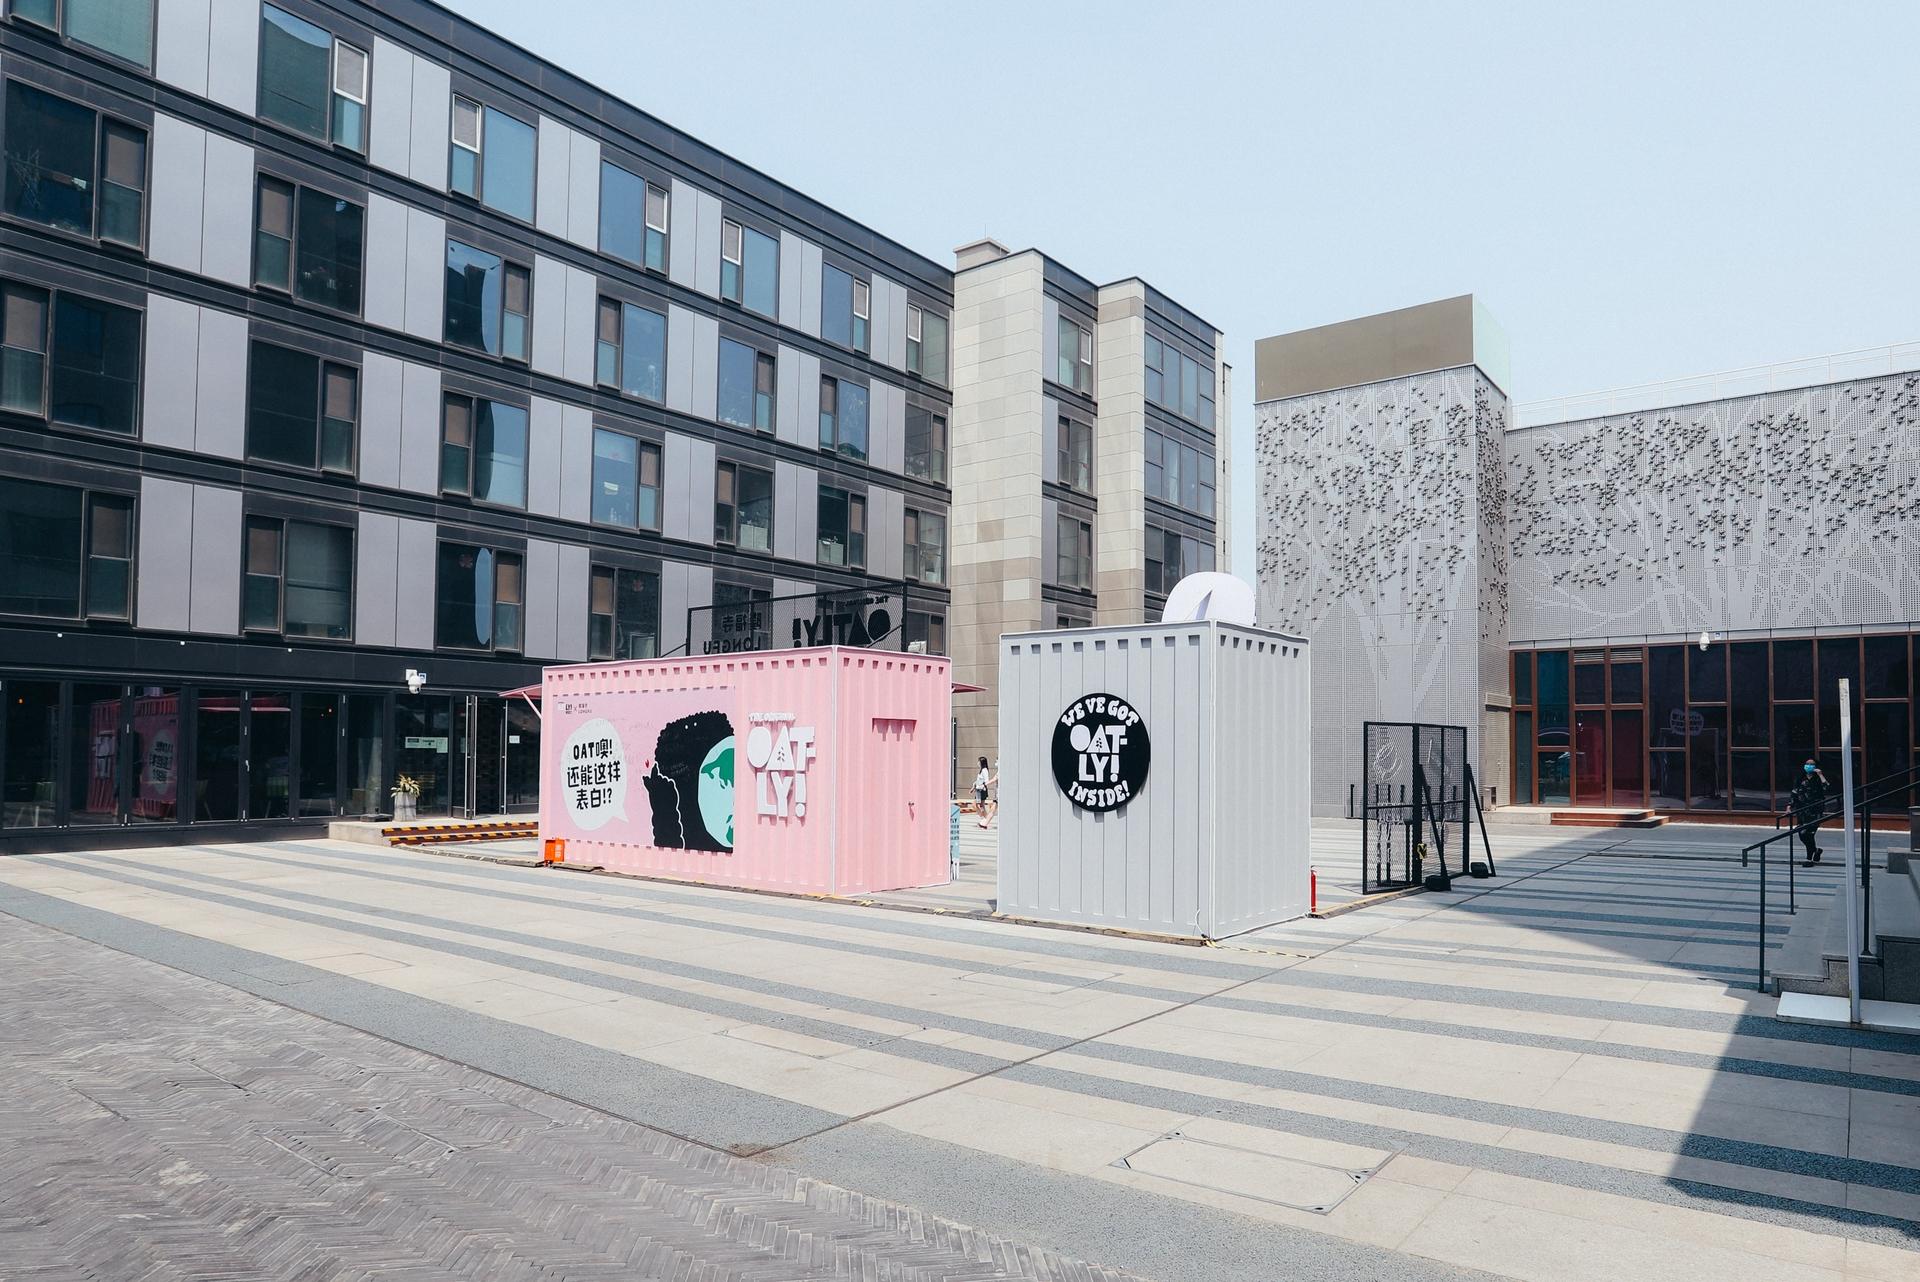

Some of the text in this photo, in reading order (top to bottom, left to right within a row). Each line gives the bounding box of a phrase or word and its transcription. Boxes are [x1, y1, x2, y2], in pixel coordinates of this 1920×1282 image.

[1107, 700, 1140, 727] GOT
[567, 760, 621, 788] 还能这样
[1078, 753, 1120, 783] LY!
[576, 788, 613, 810] 表白!?
[756, 771, 807, 818] LY!
[1068, 780, 1130, 807] INSIDE!
